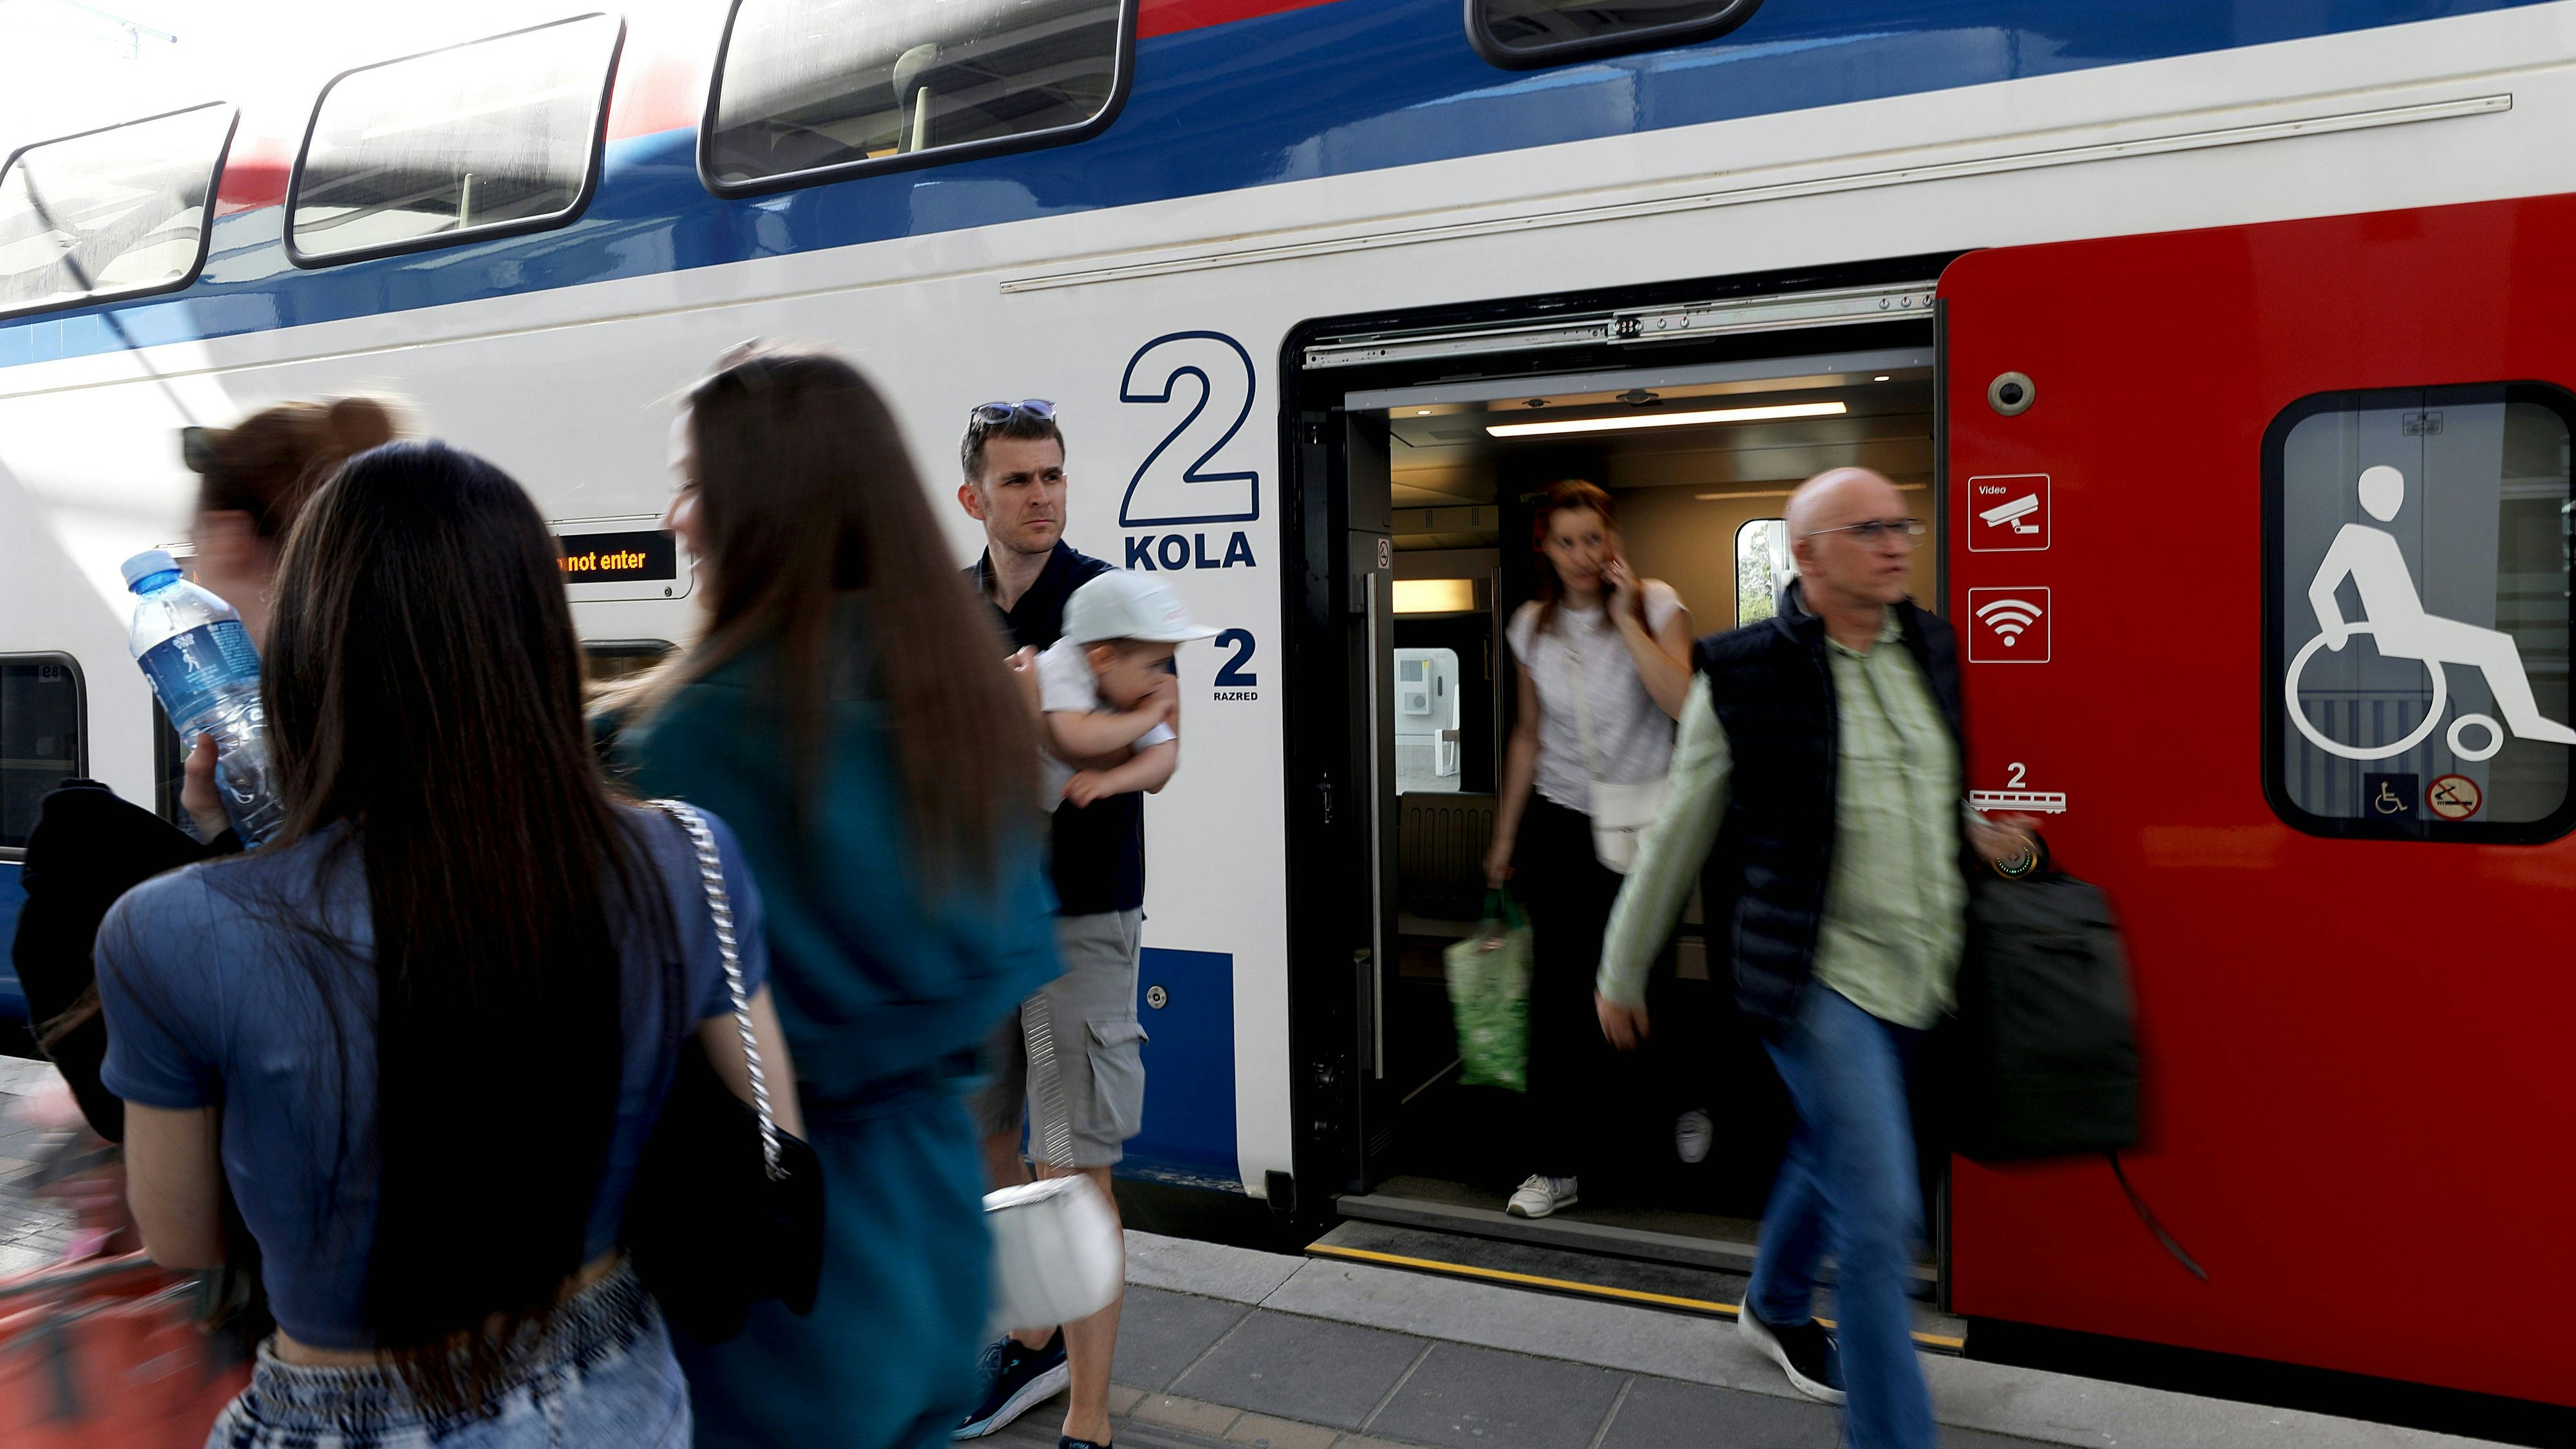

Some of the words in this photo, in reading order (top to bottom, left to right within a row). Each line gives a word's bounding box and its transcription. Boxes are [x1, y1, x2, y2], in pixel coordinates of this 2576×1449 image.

[1119, 330, 1259, 527] 2
[1979, 485, 2006, 495] Video
[568, 552, 596, 571] not
[601, 550, 645, 569] enter
[1124, 531, 1256, 571] KOLA
[1214, 628, 1256, 687] 2
[1213, 692, 1258, 701] RAZRED
[2007, 762, 2025, 788] 2
